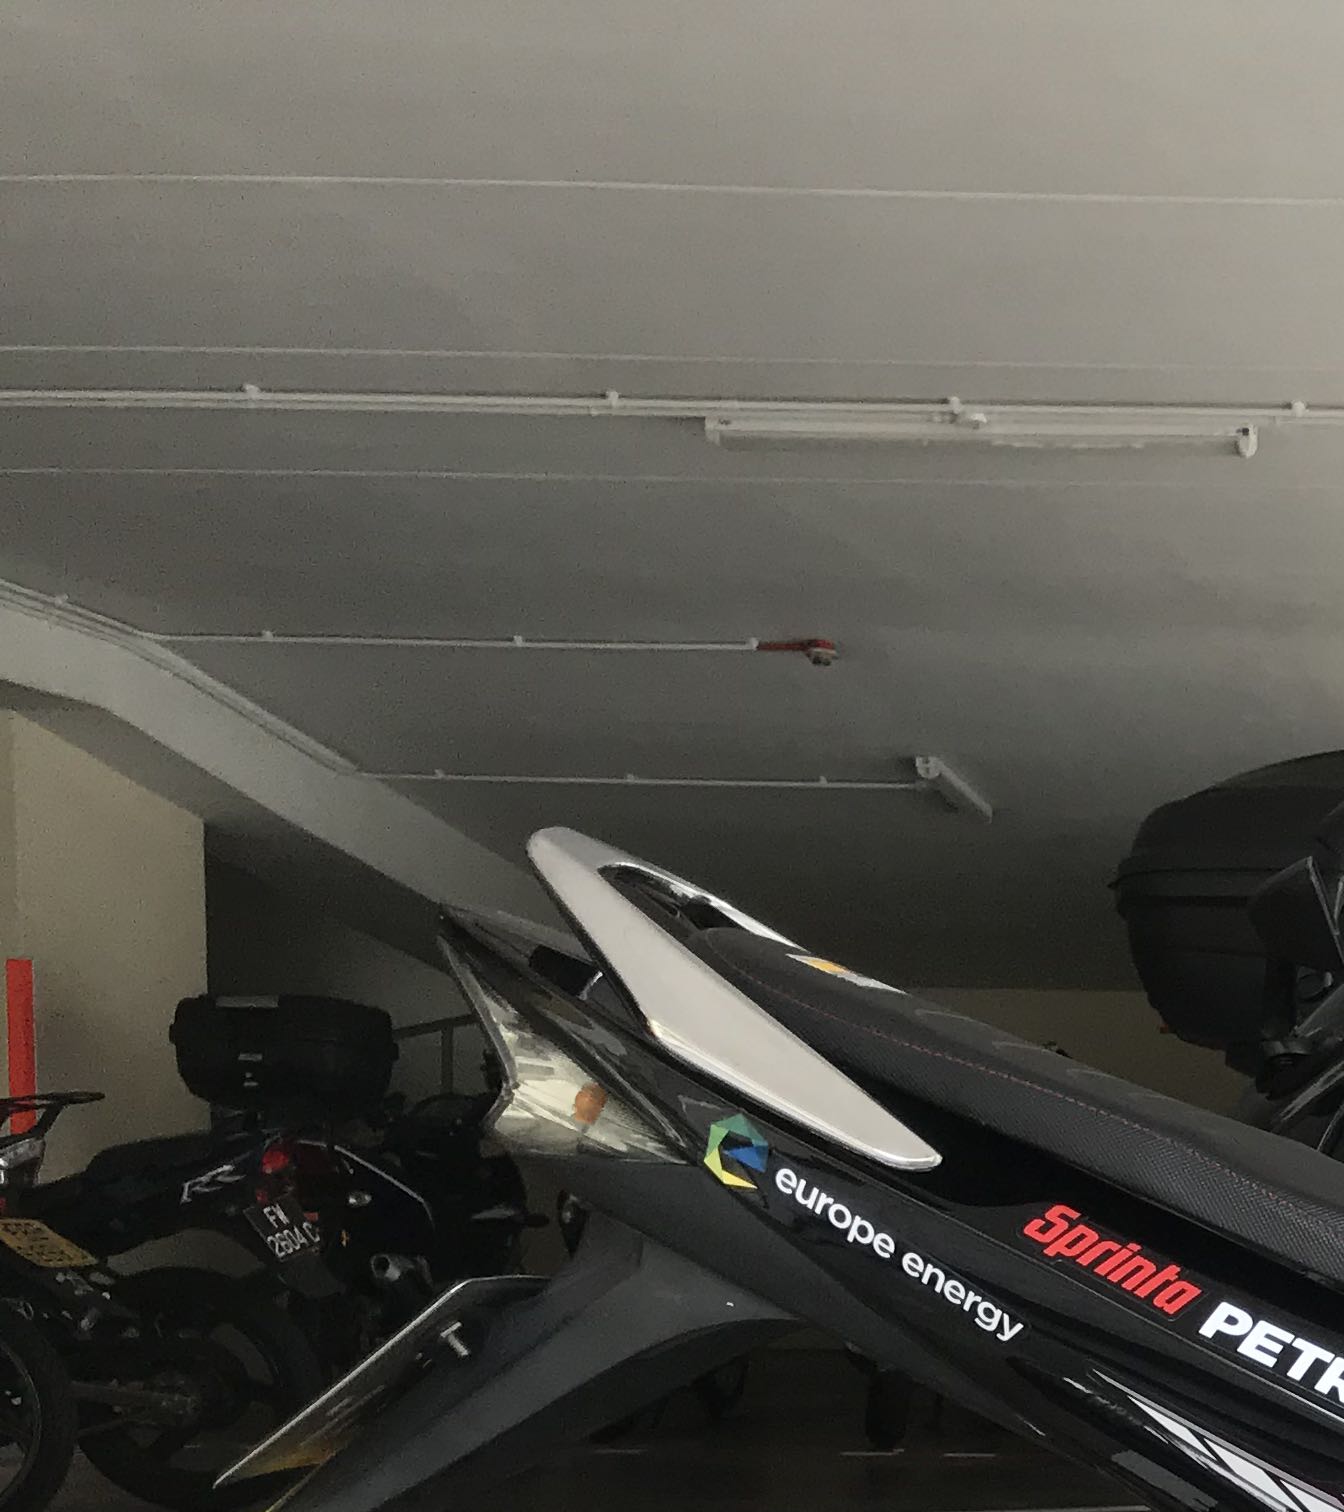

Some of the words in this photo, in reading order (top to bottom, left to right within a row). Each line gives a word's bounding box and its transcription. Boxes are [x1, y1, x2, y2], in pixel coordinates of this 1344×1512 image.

[774, 1166, 896, 1259] europe
[901, 1251, 1025, 1343] energy
[1023, 1203, 1202, 1316] Sprinta
